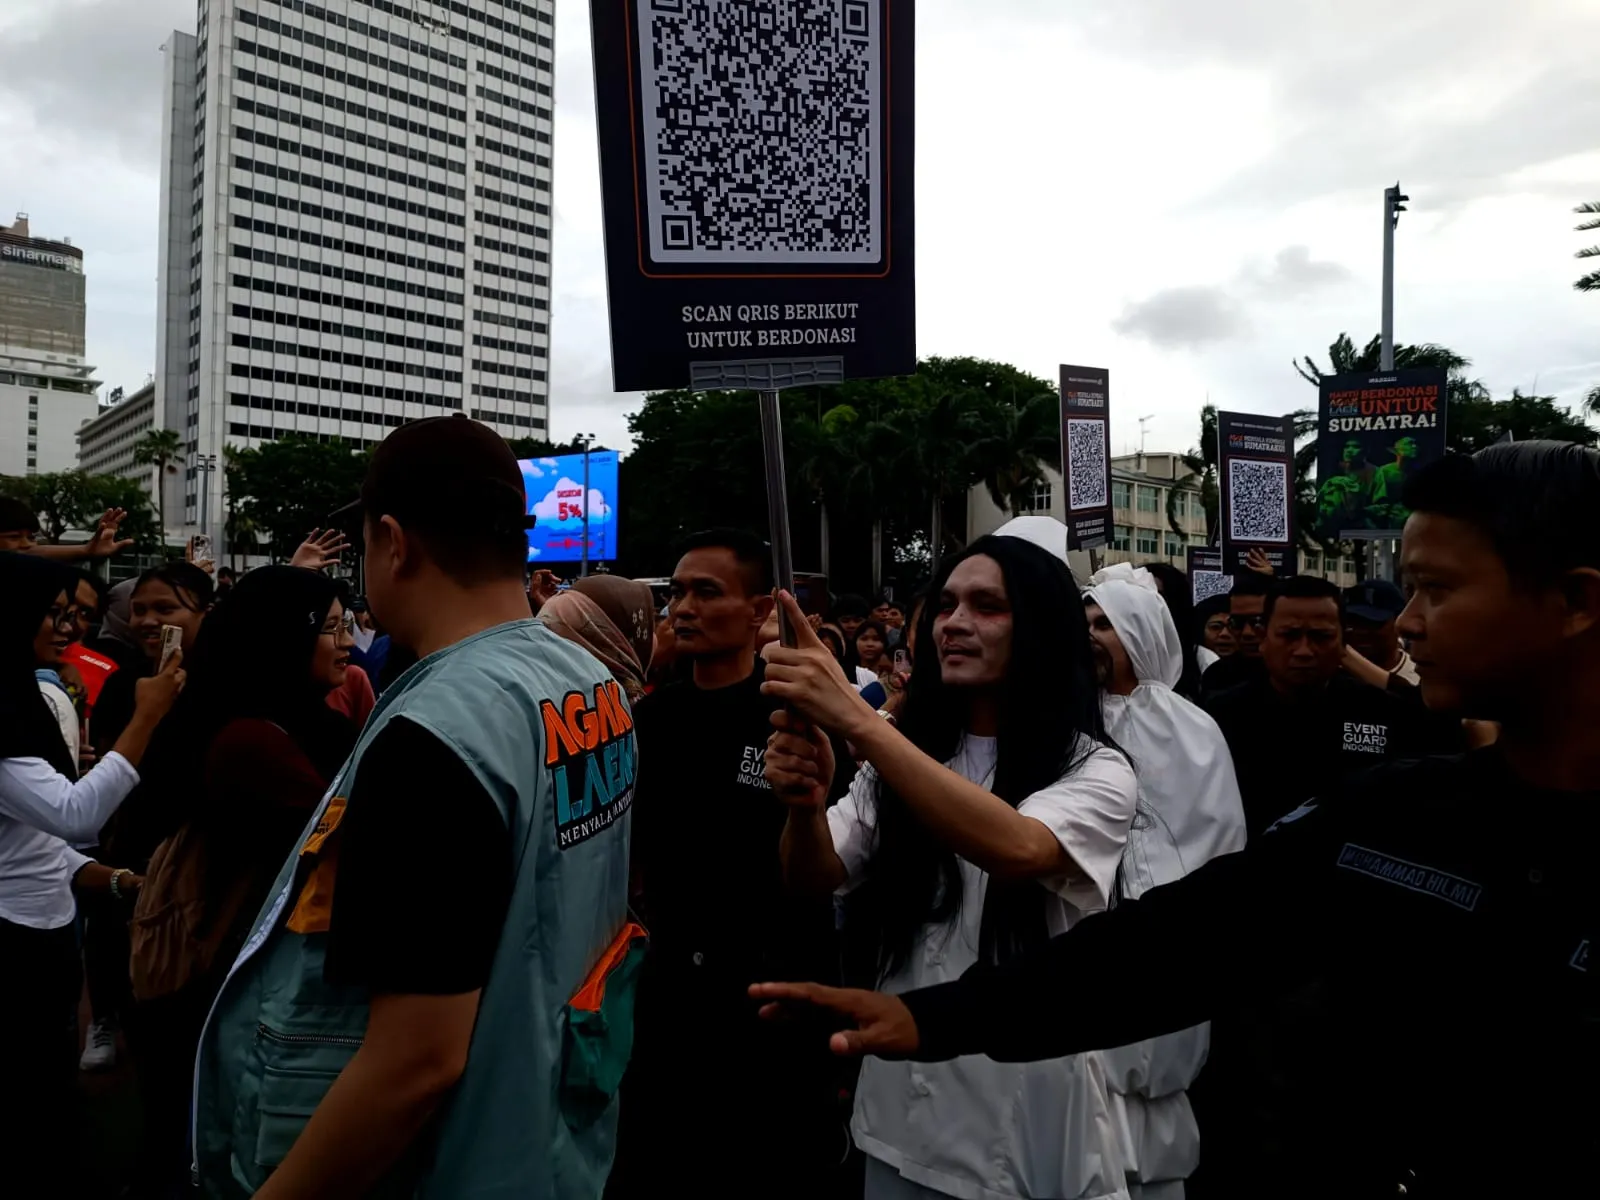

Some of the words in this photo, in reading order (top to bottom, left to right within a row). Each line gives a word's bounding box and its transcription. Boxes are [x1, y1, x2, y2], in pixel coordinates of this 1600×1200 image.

[682, 305, 732, 323] SCAN
[737, 304, 780, 323] QRIS
[784, 303, 859, 320] BERIKUT
[687, 331, 752, 348] UNTUK
[757, 327, 857, 346] BERDONASI
[1361, 384, 1439, 399] BERDONASI
[1361, 396, 1438, 415] UNTUK
[1328, 413, 1437, 433] SUMATRA!
[558, 502, 583, 521] 5%
[541, 680, 633, 767] AGAK
[1343, 722, 1388, 736] EVENT
[1343, 732, 1387, 746] GUARD
[743, 746, 765, 761] EV
[553, 734, 634, 827] LAEN
[736, 772, 773, 789] INDONE
[560, 808, 613, 846] MENYALA
